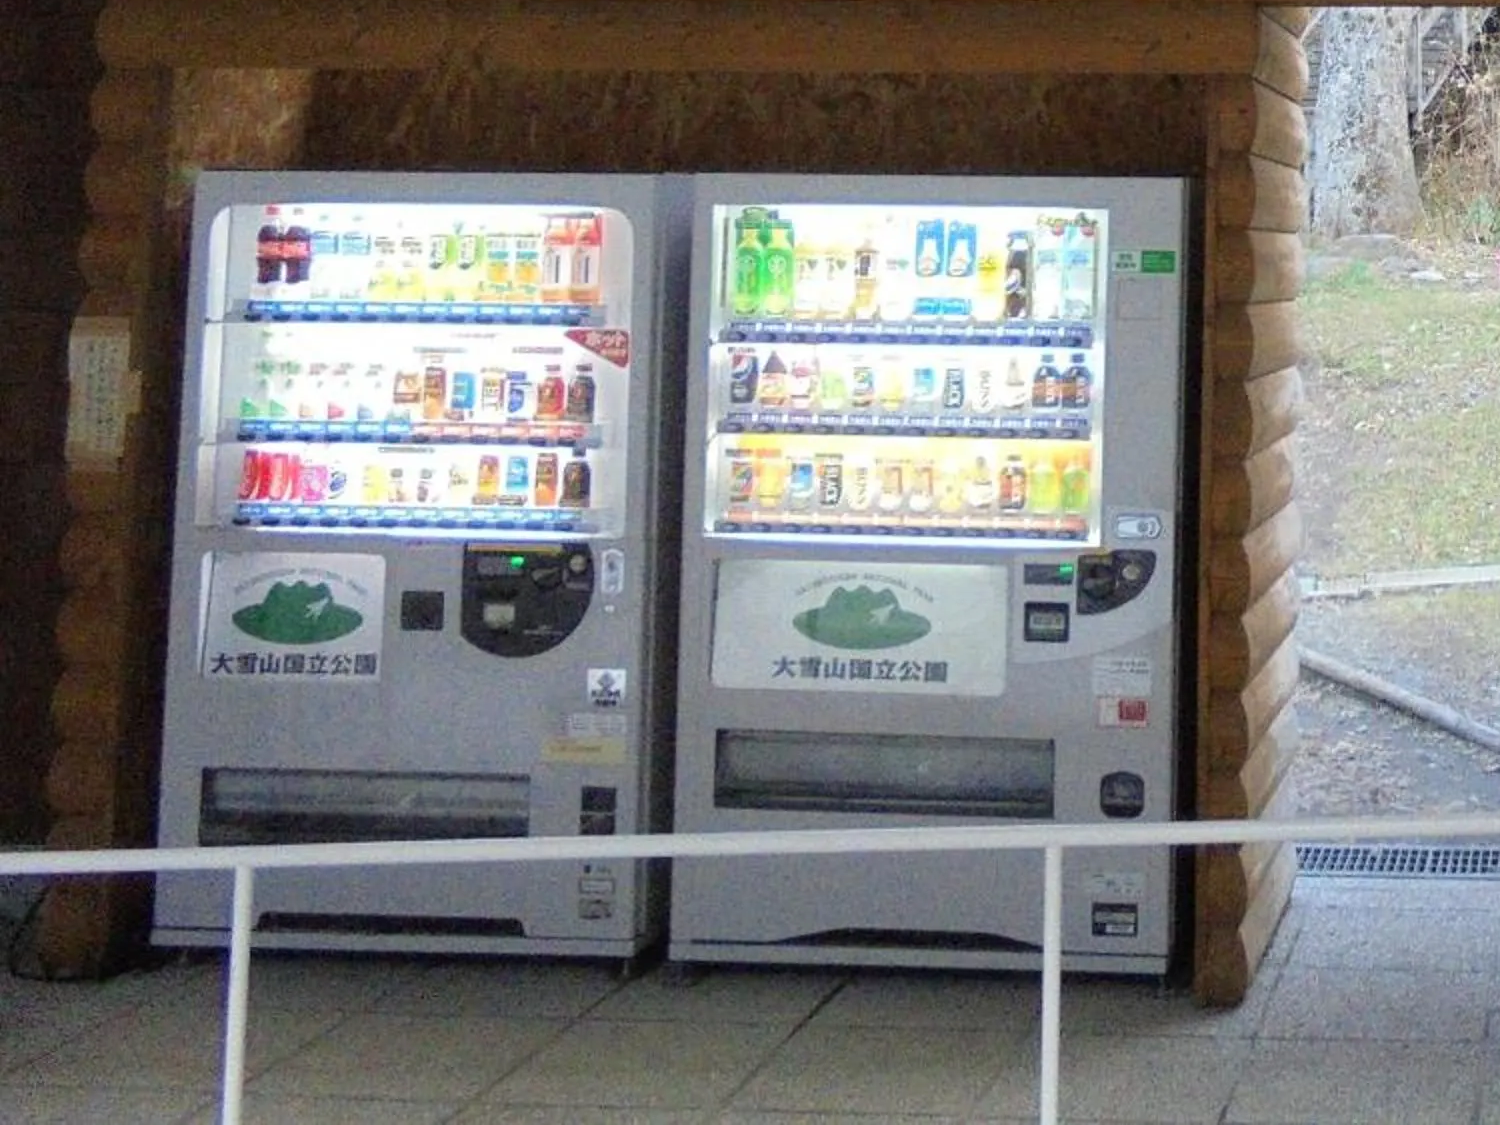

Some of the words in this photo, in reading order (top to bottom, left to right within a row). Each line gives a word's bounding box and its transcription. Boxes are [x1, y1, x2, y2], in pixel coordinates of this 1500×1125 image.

[210, 651, 379, 676] 大雪山国立公園
[771, 655, 949, 684] 大雪山国立公園
